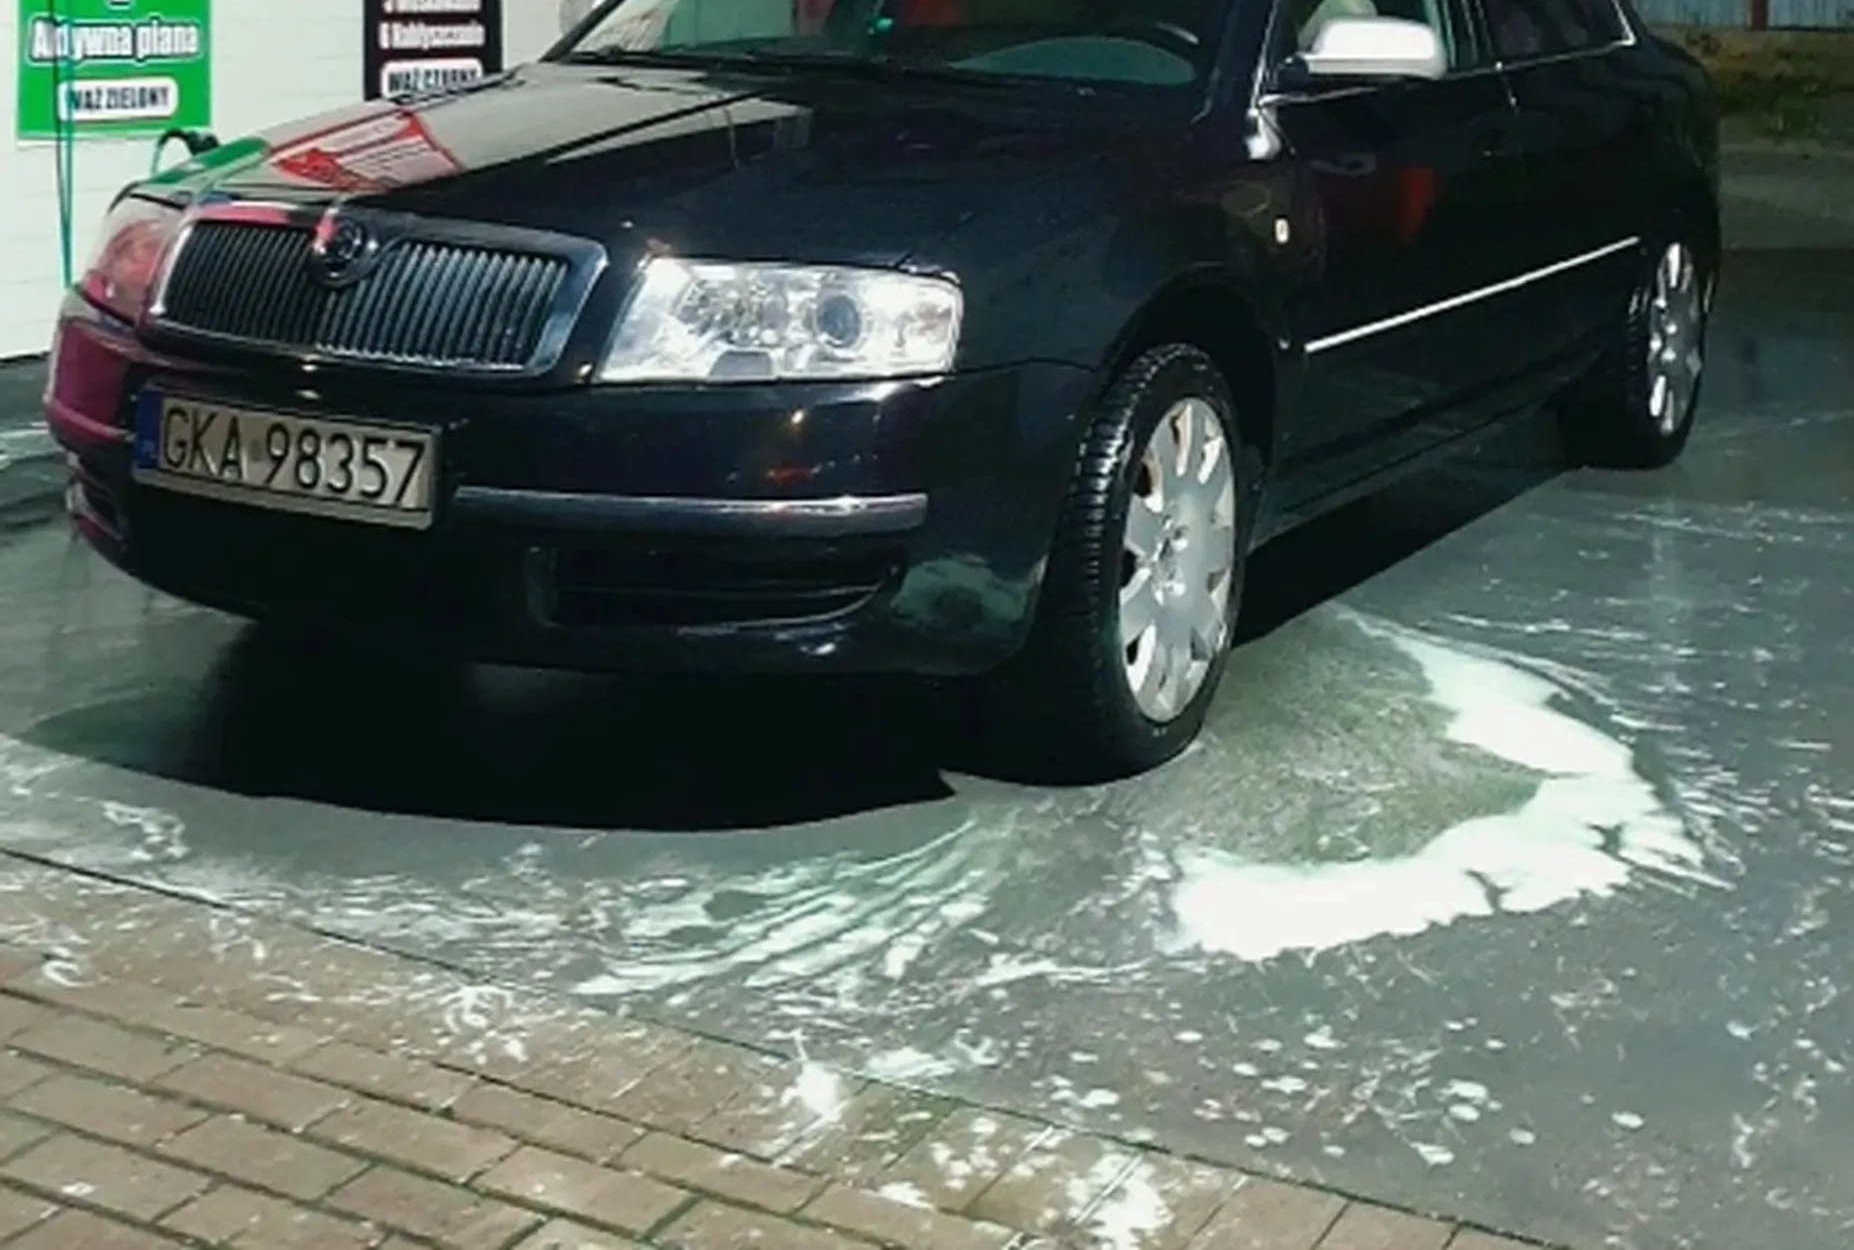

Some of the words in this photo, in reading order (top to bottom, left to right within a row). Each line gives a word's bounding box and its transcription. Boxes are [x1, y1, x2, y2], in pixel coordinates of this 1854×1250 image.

[136, 17, 199, 59] piana
[105, 86, 169, 110] ZIELONY
[163, 407, 245, 480] GKA
[265, 422, 425, 507] 98357
